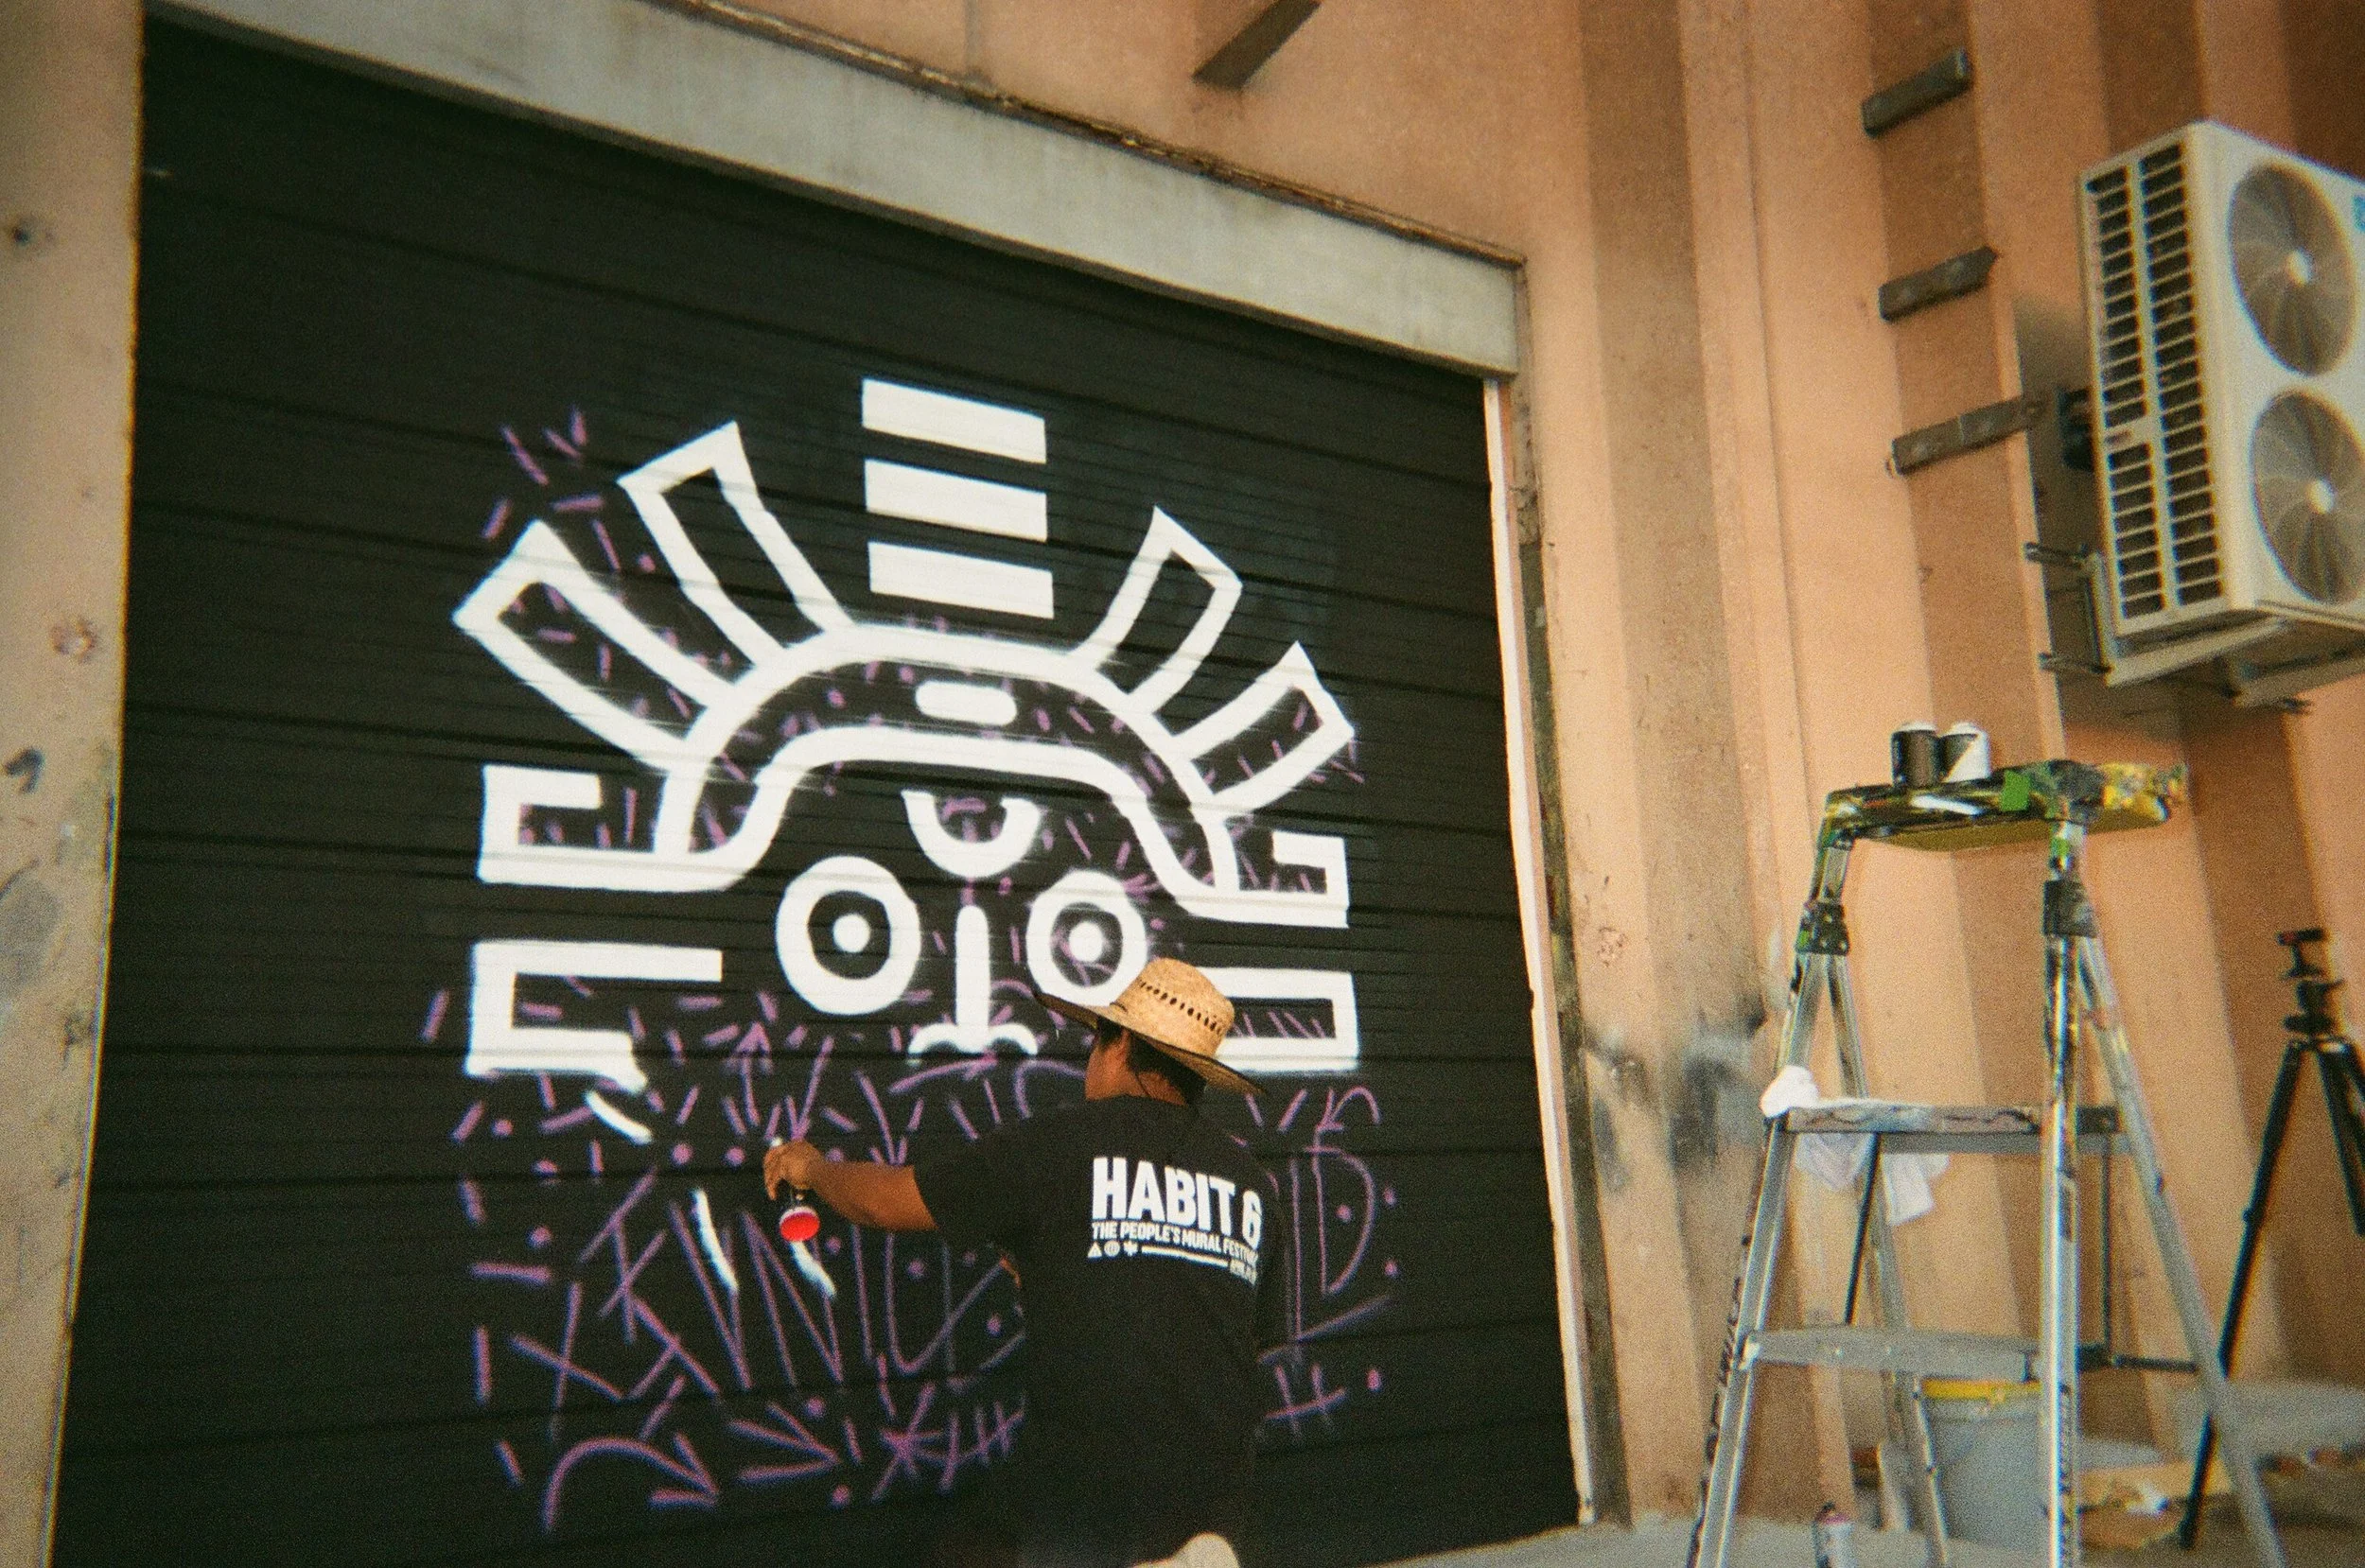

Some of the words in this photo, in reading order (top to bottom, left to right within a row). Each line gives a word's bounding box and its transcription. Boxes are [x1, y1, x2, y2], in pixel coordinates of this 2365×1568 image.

[1092, 1157, 1236, 1237] HABIT
[1242, 1188, 1263, 1250] 6
[1092, 1221, 1118, 1240] THE
[1120, 1220, 1182, 1246] PEOPLE'S
[1182, 1228, 1222, 1255] MURAL
